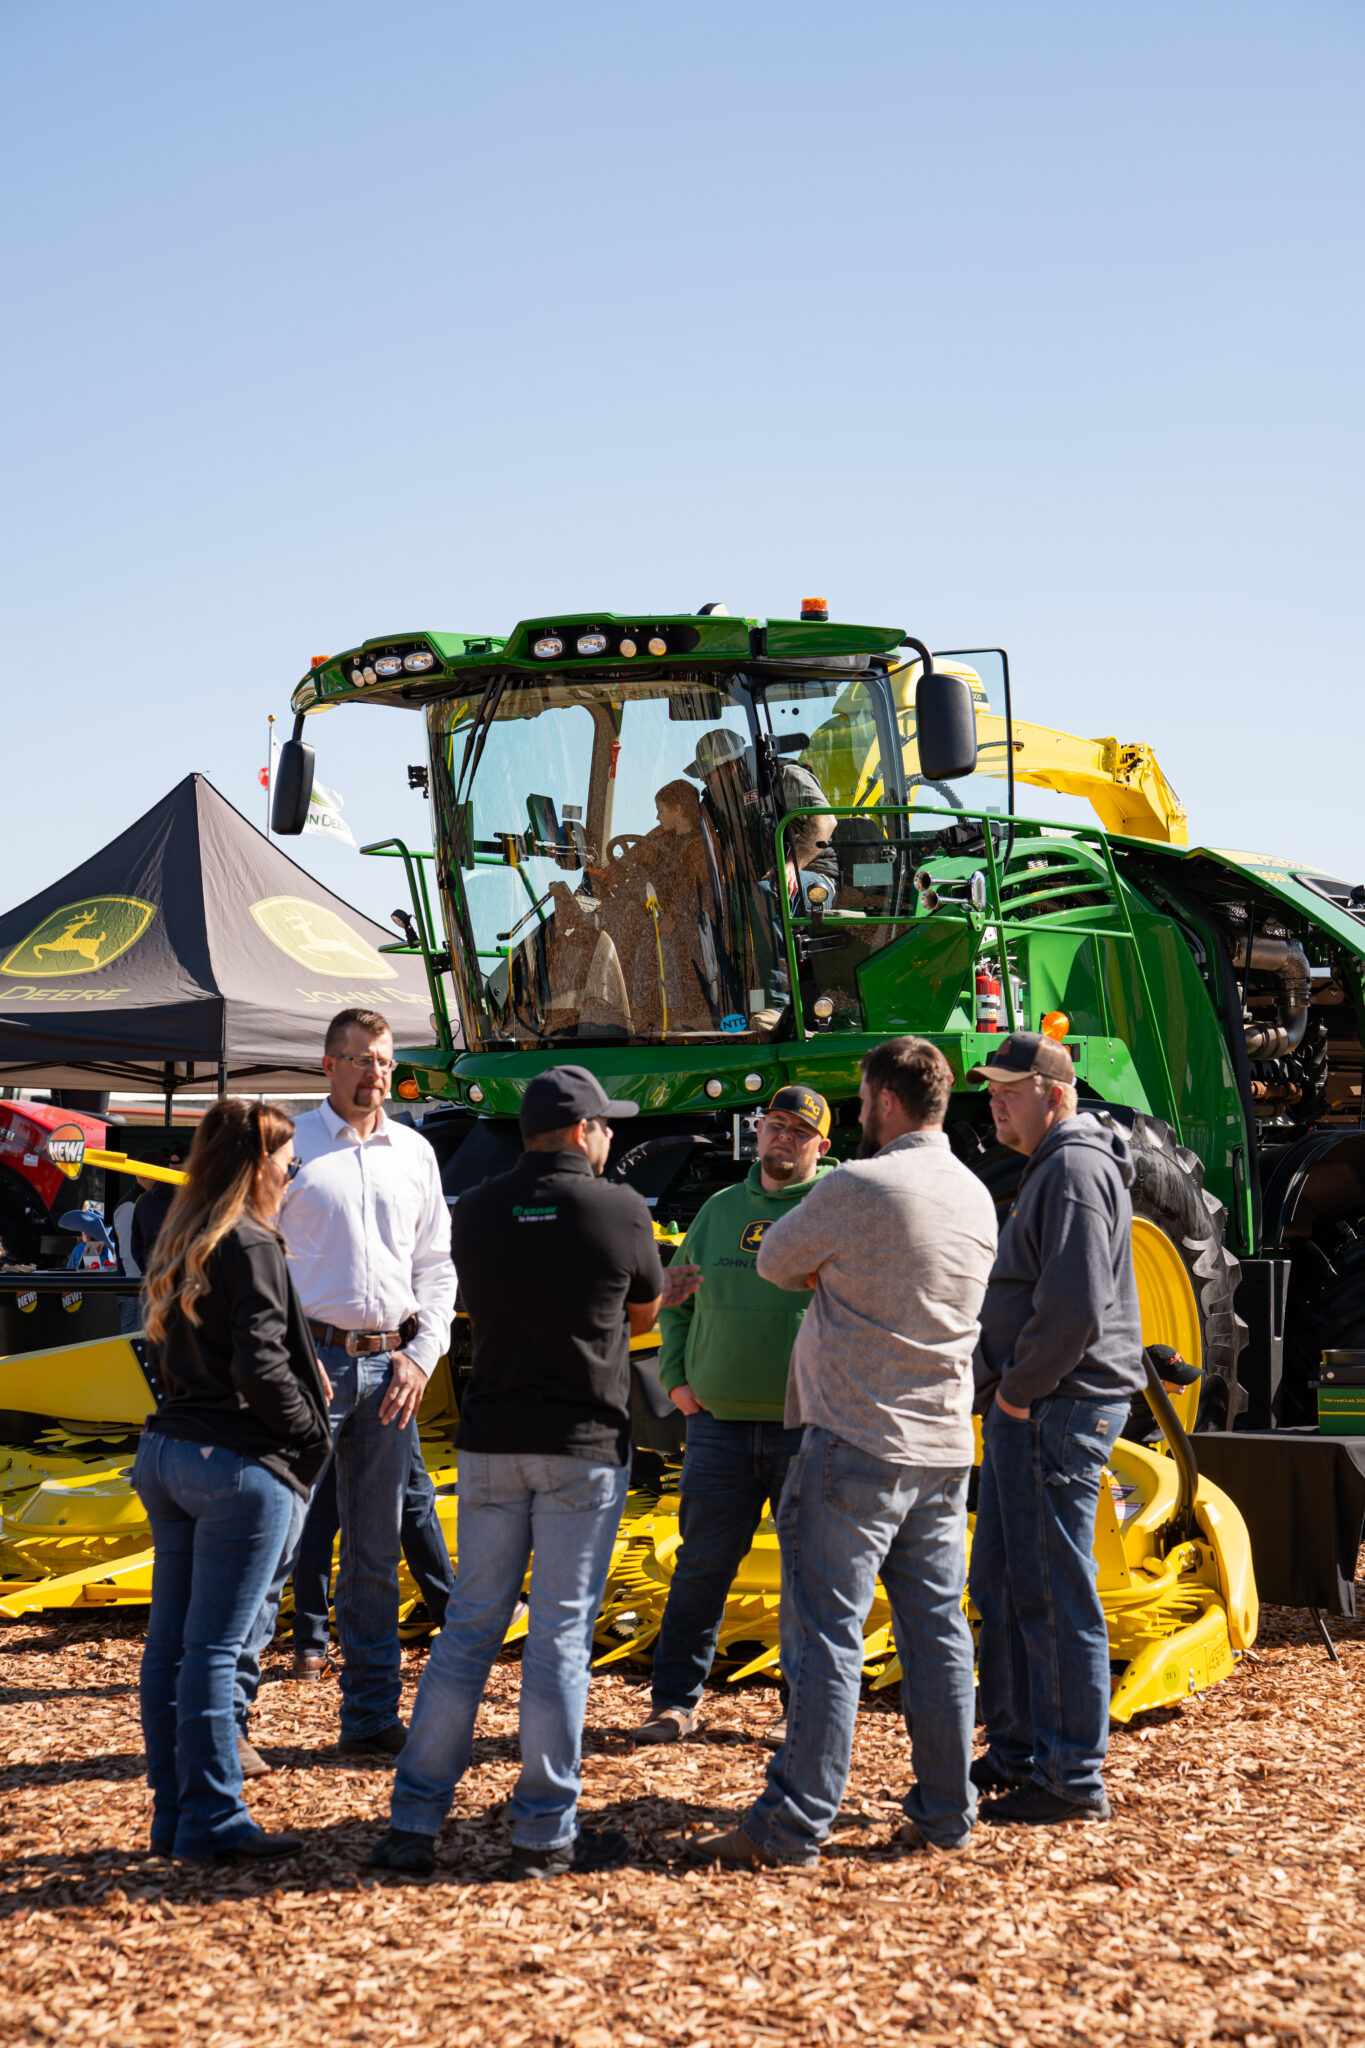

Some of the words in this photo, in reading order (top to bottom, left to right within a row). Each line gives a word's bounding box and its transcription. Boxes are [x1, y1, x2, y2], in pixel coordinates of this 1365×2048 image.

[0, 986, 132, 1001] DEERE
[296, 988, 378, 1005] JOHN
[804, 1094, 821, 1116] T&G
[48, 1141, 85, 1162] NEW!
[714, 1257, 748, 1269] JOHN
[17, 1291, 38, 1309] NEW!
[62, 1292, 83, 1309] NEW!
